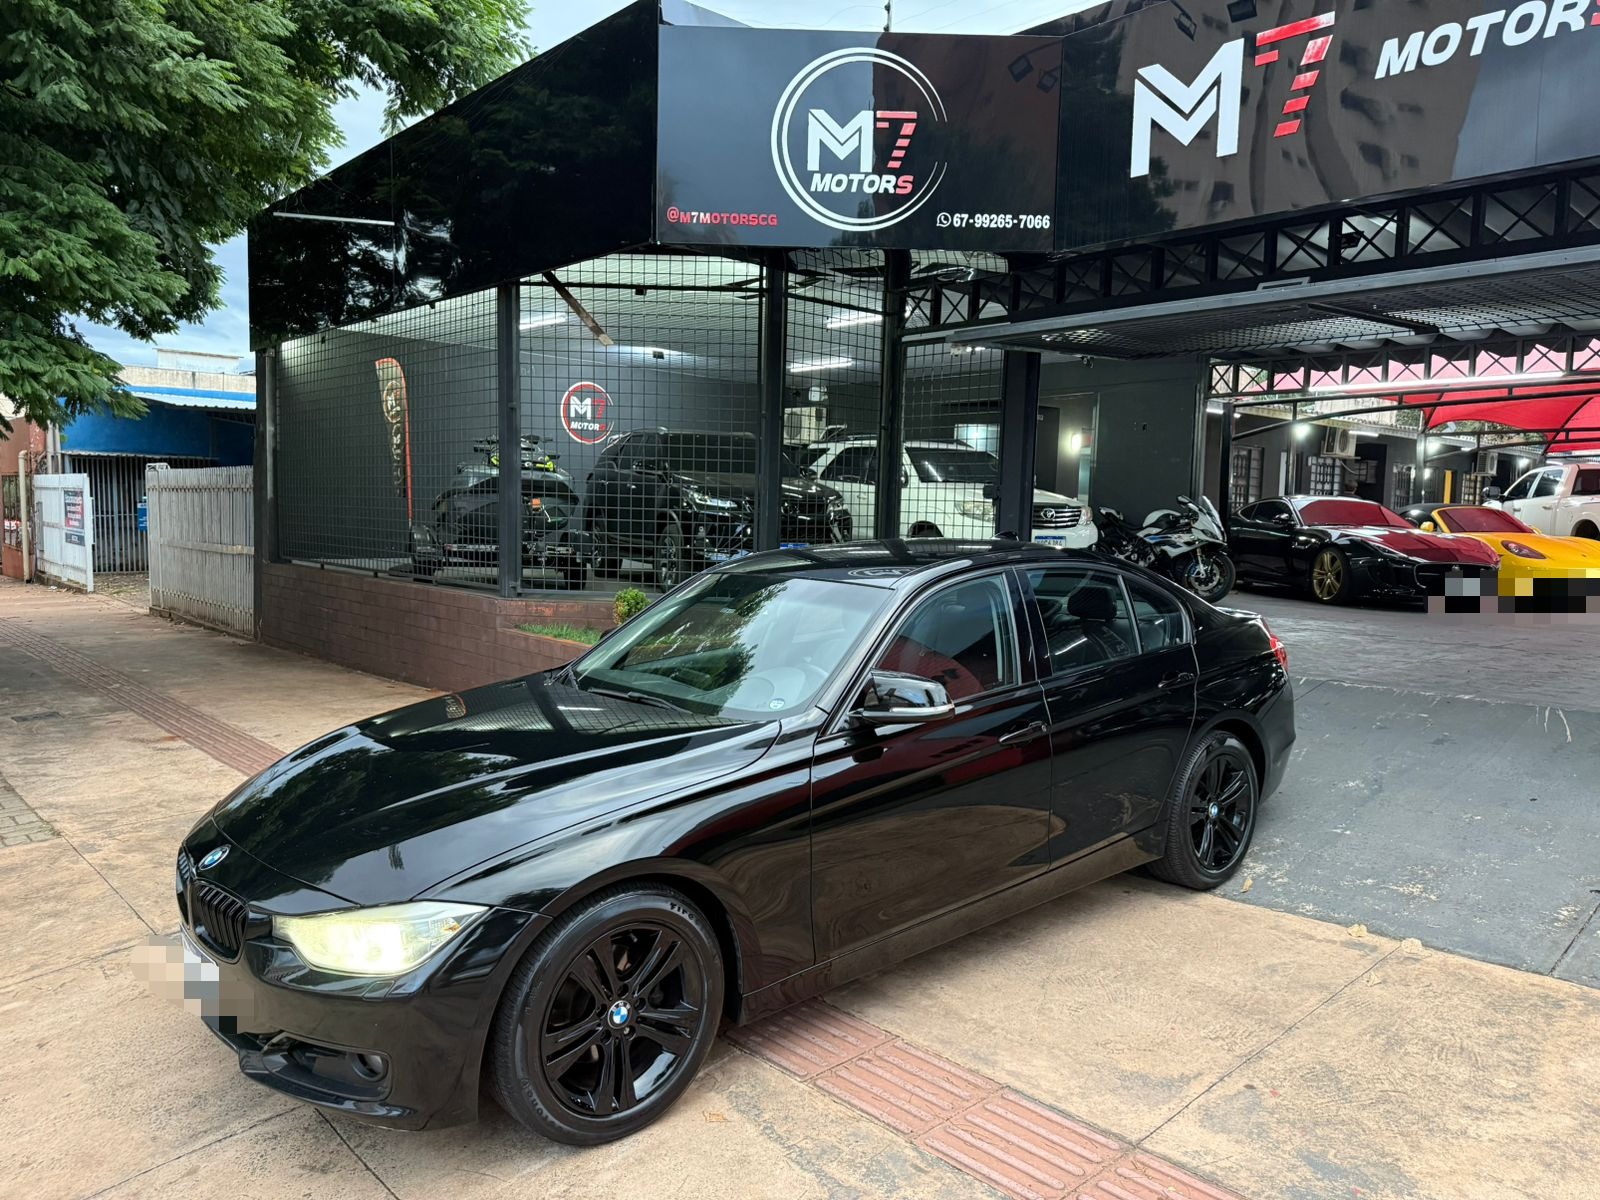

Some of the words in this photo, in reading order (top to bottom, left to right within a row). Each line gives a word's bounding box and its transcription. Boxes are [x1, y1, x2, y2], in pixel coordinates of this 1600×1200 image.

[1130, 11, 1336, 178] M7
[1374, 0, 1600, 80] MOTOR
[807, 109, 918, 172] M7
[810, 173, 914, 195] MOTORS
[666, 206, 778, 227] @M7MOTORSCG
[953, 213, 1050, 230] 67-99265-7066
[569, 395, 606, 420] M7
[569, 421, 606, 432] MOTORS
